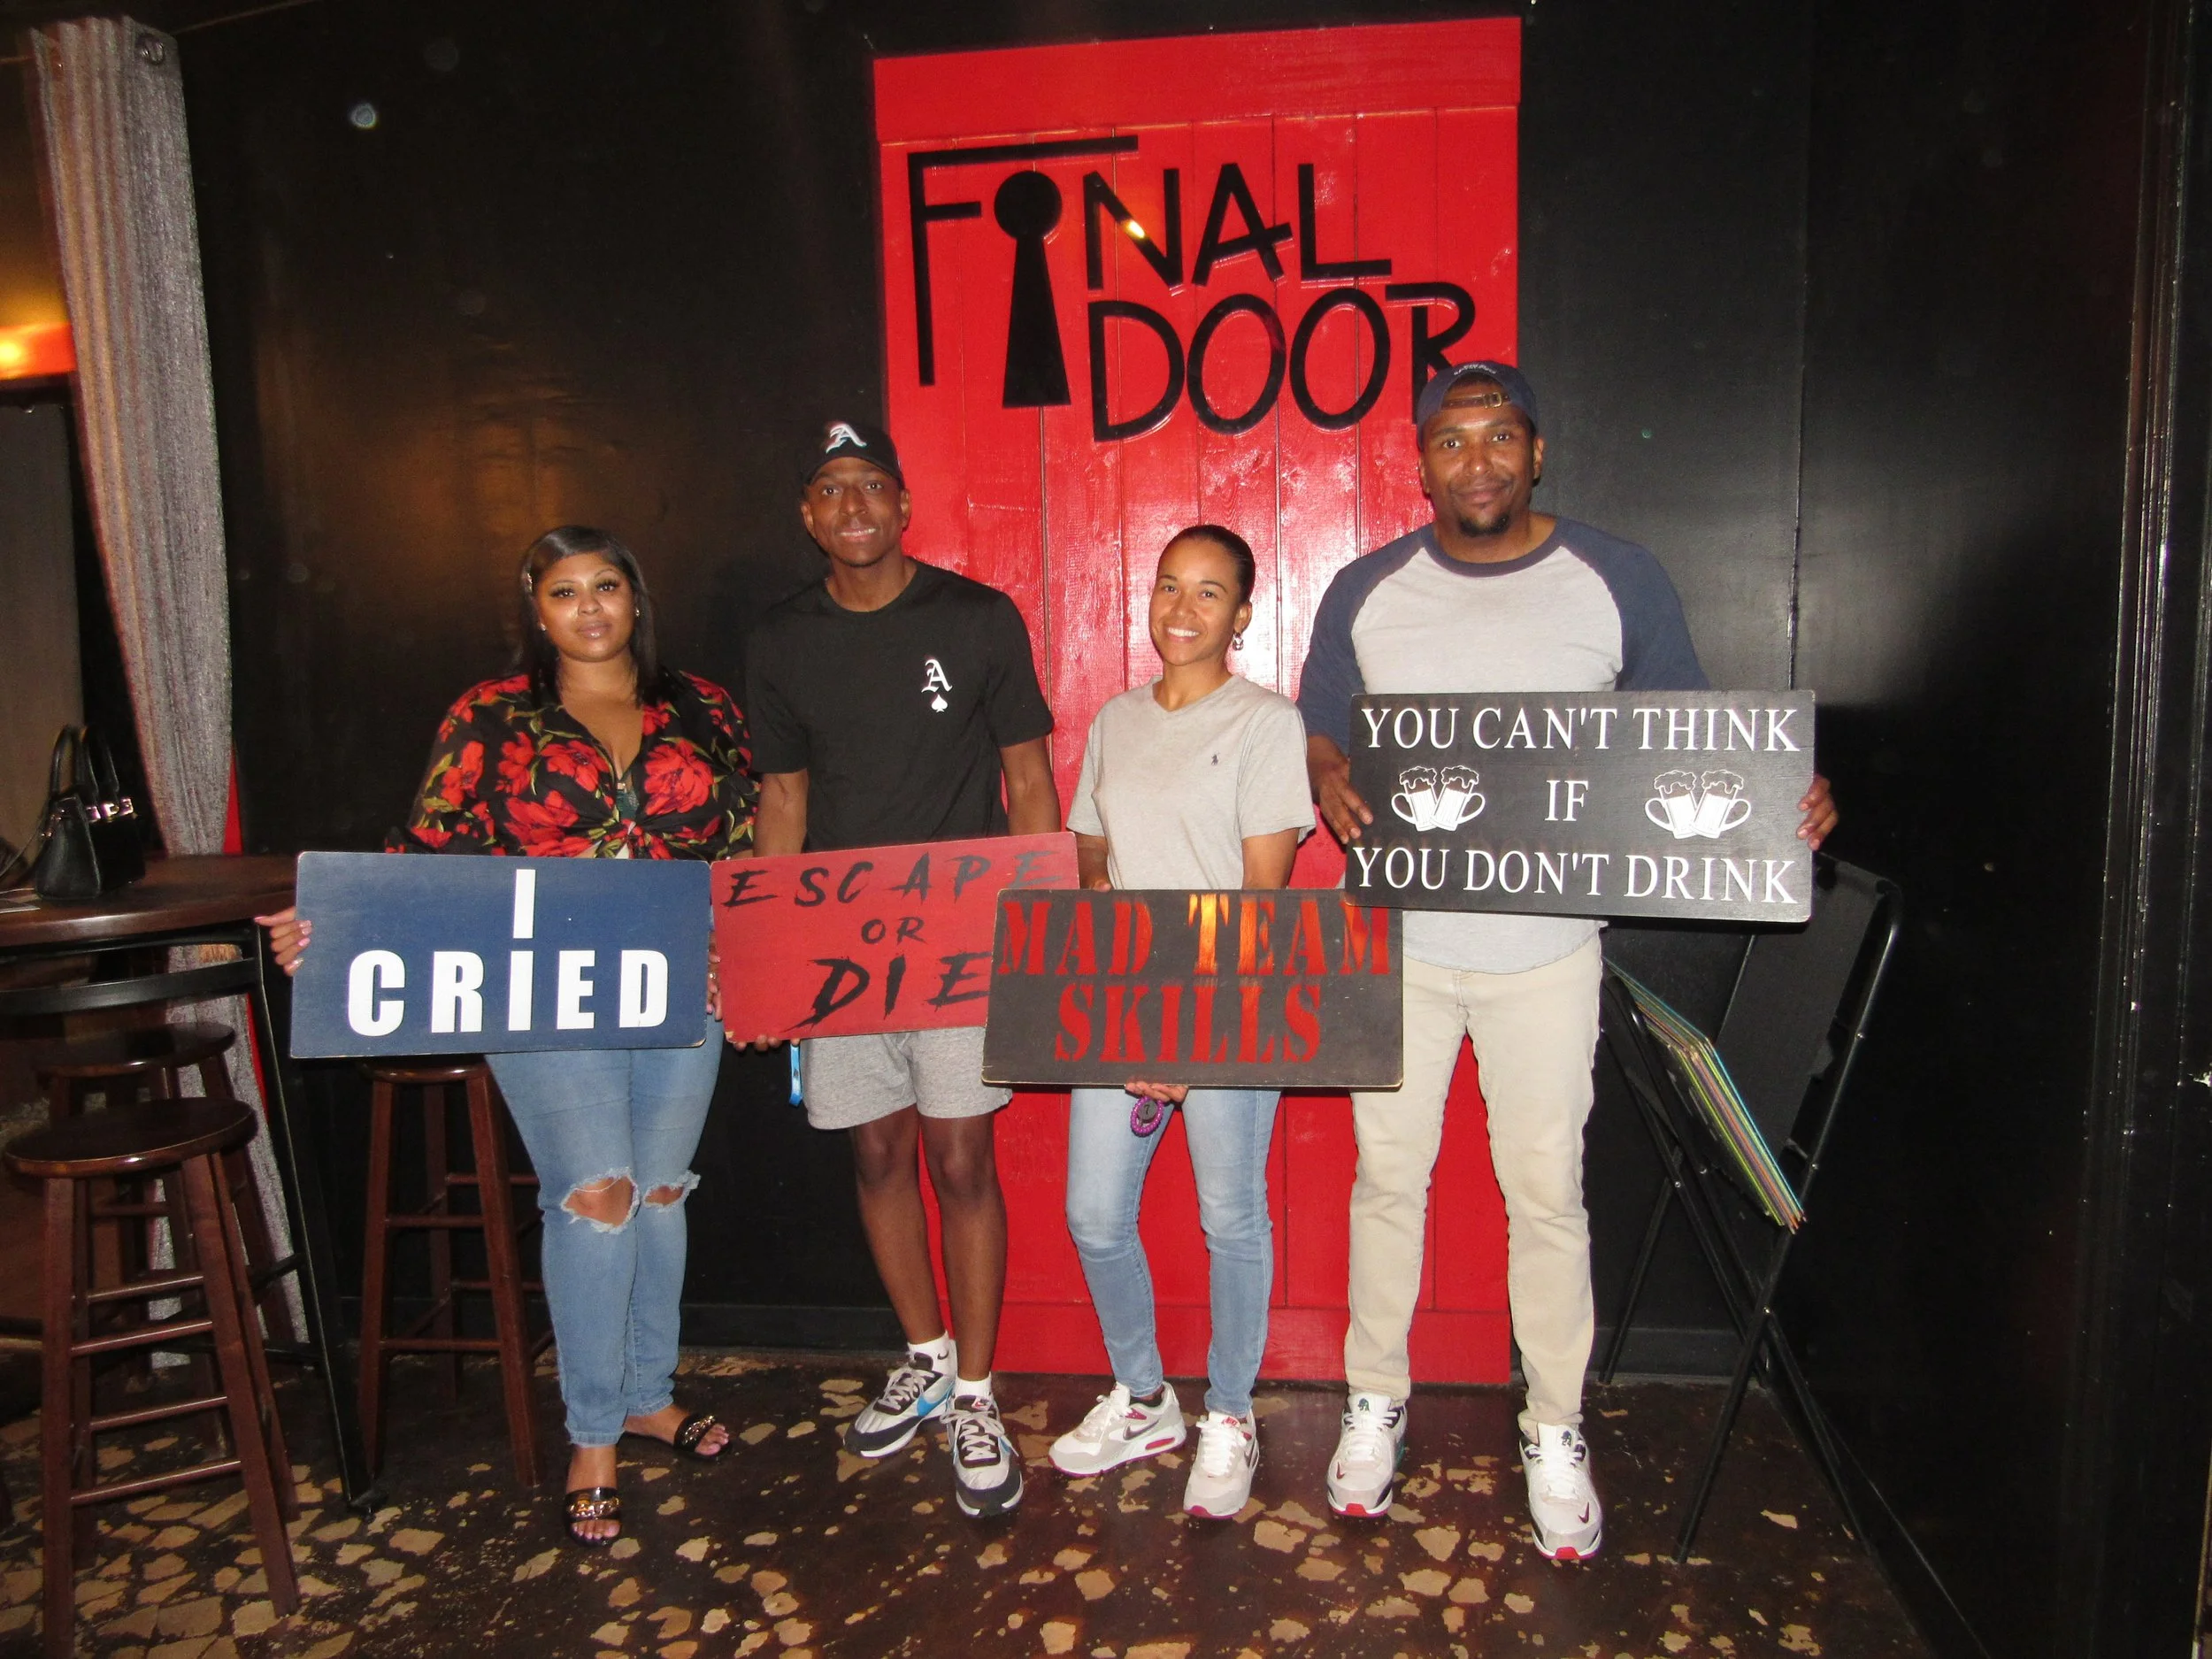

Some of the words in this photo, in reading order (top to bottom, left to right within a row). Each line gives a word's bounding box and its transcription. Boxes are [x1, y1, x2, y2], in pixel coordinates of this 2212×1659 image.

[1087, 281, 1476, 442] DOOR
[921, 658, 953, 693] A
[1361, 708, 1460, 749] YOU
[1472, 707, 1618, 750] CAN'T
[1632, 708, 1801, 752] THINK
[1544, 780, 1589, 822] IF
[512, 868, 536, 939] I
[722, 850, 1061, 910] ESCAPE
[1353, 847, 1453, 890] YOU
[1463, 849, 1610, 896] DON'T
[1624, 854, 1799, 904] DRINK
[860, 917, 927, 944] OR
[997, 898, 1153, 975] MAD
[1188, 893, 1390, 975] TEAM
[348, 949, 669, 1037] CRIED
[784, 952, 993, 1033] DIE
[1055, 980, 1322, 1064] SKILLS
